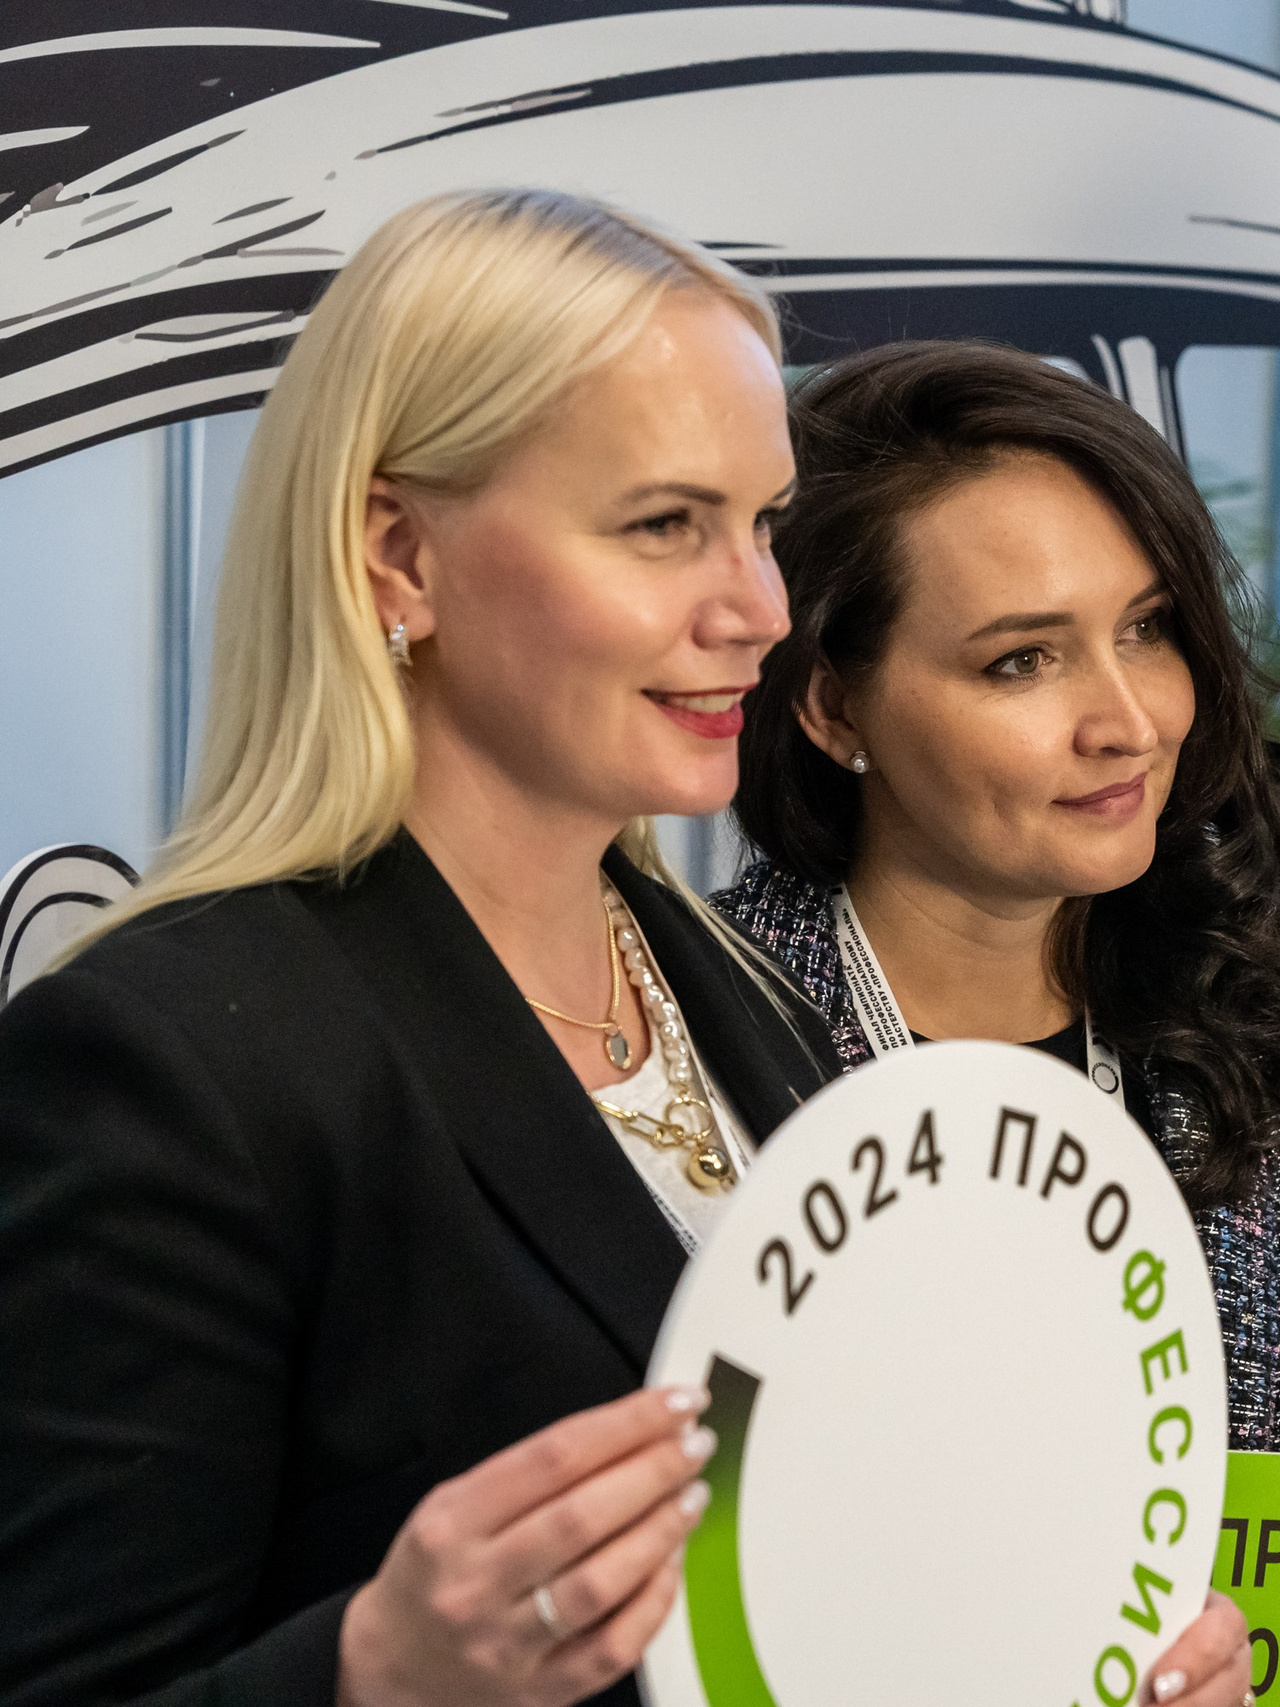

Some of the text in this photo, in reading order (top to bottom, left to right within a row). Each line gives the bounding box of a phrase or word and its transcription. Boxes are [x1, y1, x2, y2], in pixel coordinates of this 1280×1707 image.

[842, 908, 908, 1047] МАСТЕРСТВУ «ПРОФЕССИОНАЛЫ»
[844, 941, 899, 1049] ПО ПРОФЕССИОНАЛЬНОМУ
[847, 964, 890, 1051] ФИНАЛ ЧЕМПИОНАТА
[755, 1105, 1194, 1707] 2024 ПРОФЕССИО
